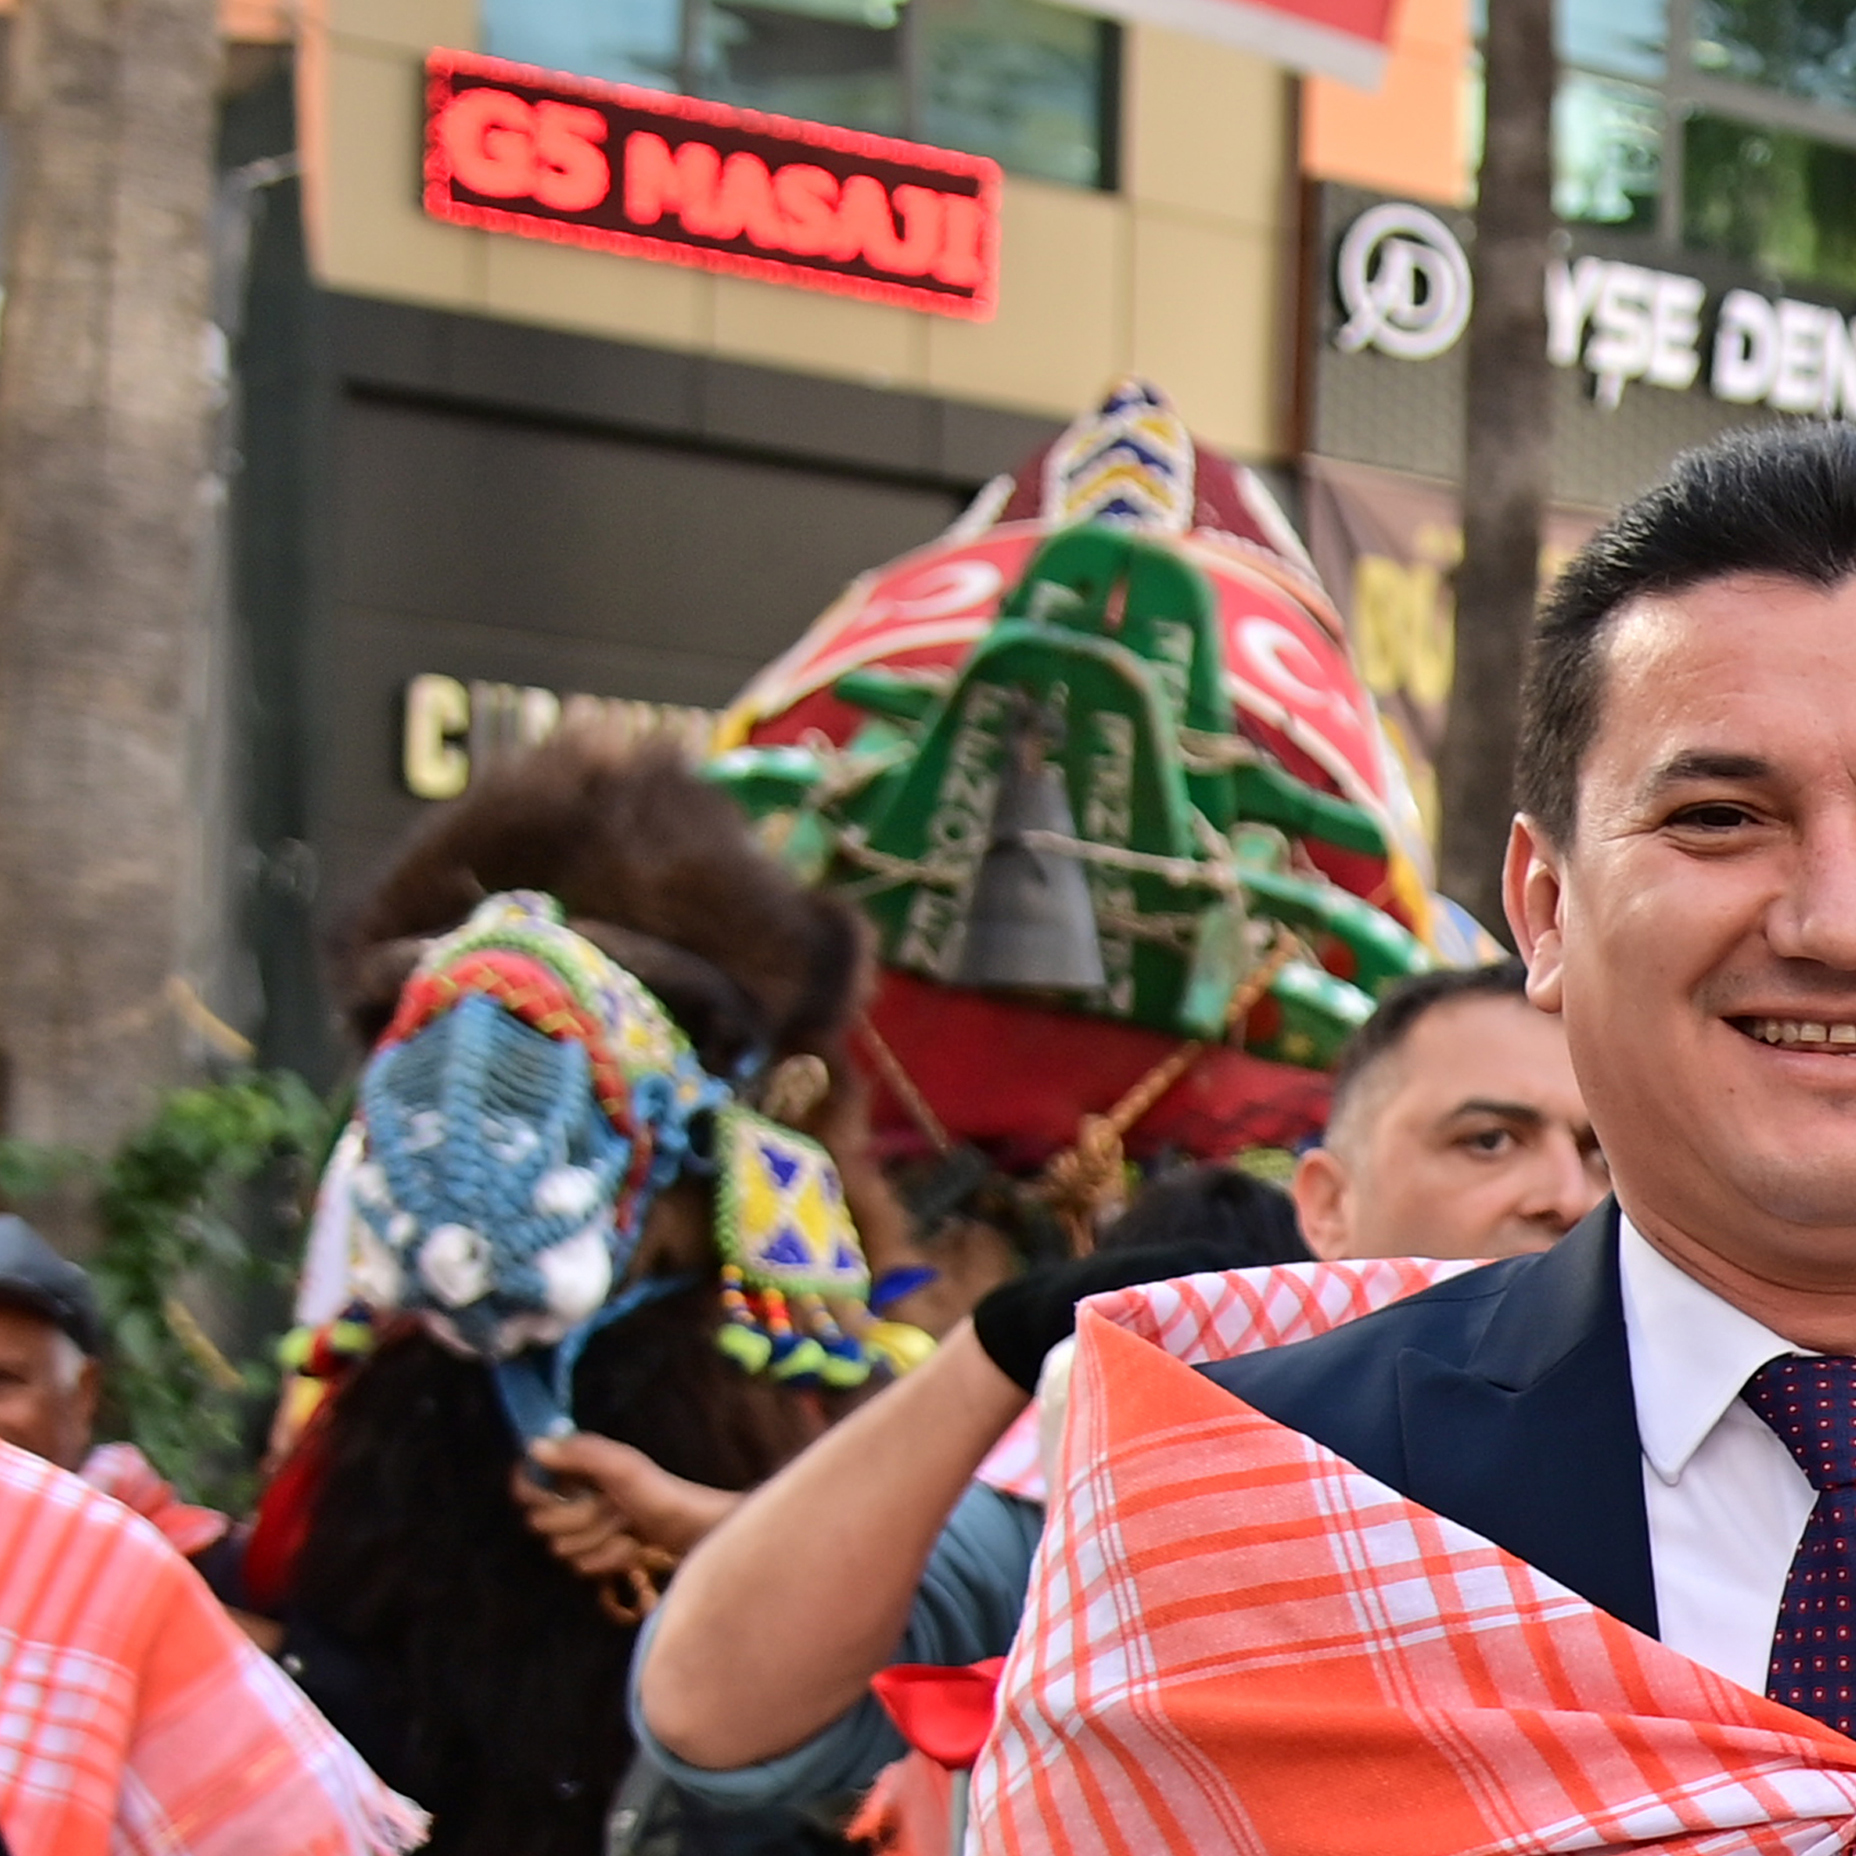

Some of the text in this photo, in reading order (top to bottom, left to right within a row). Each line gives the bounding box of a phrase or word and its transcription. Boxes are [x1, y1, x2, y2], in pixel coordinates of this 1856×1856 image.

[443, 87, 985, 287] G5 MASAJI
[1545, 255, 1706, 411] YŞE
